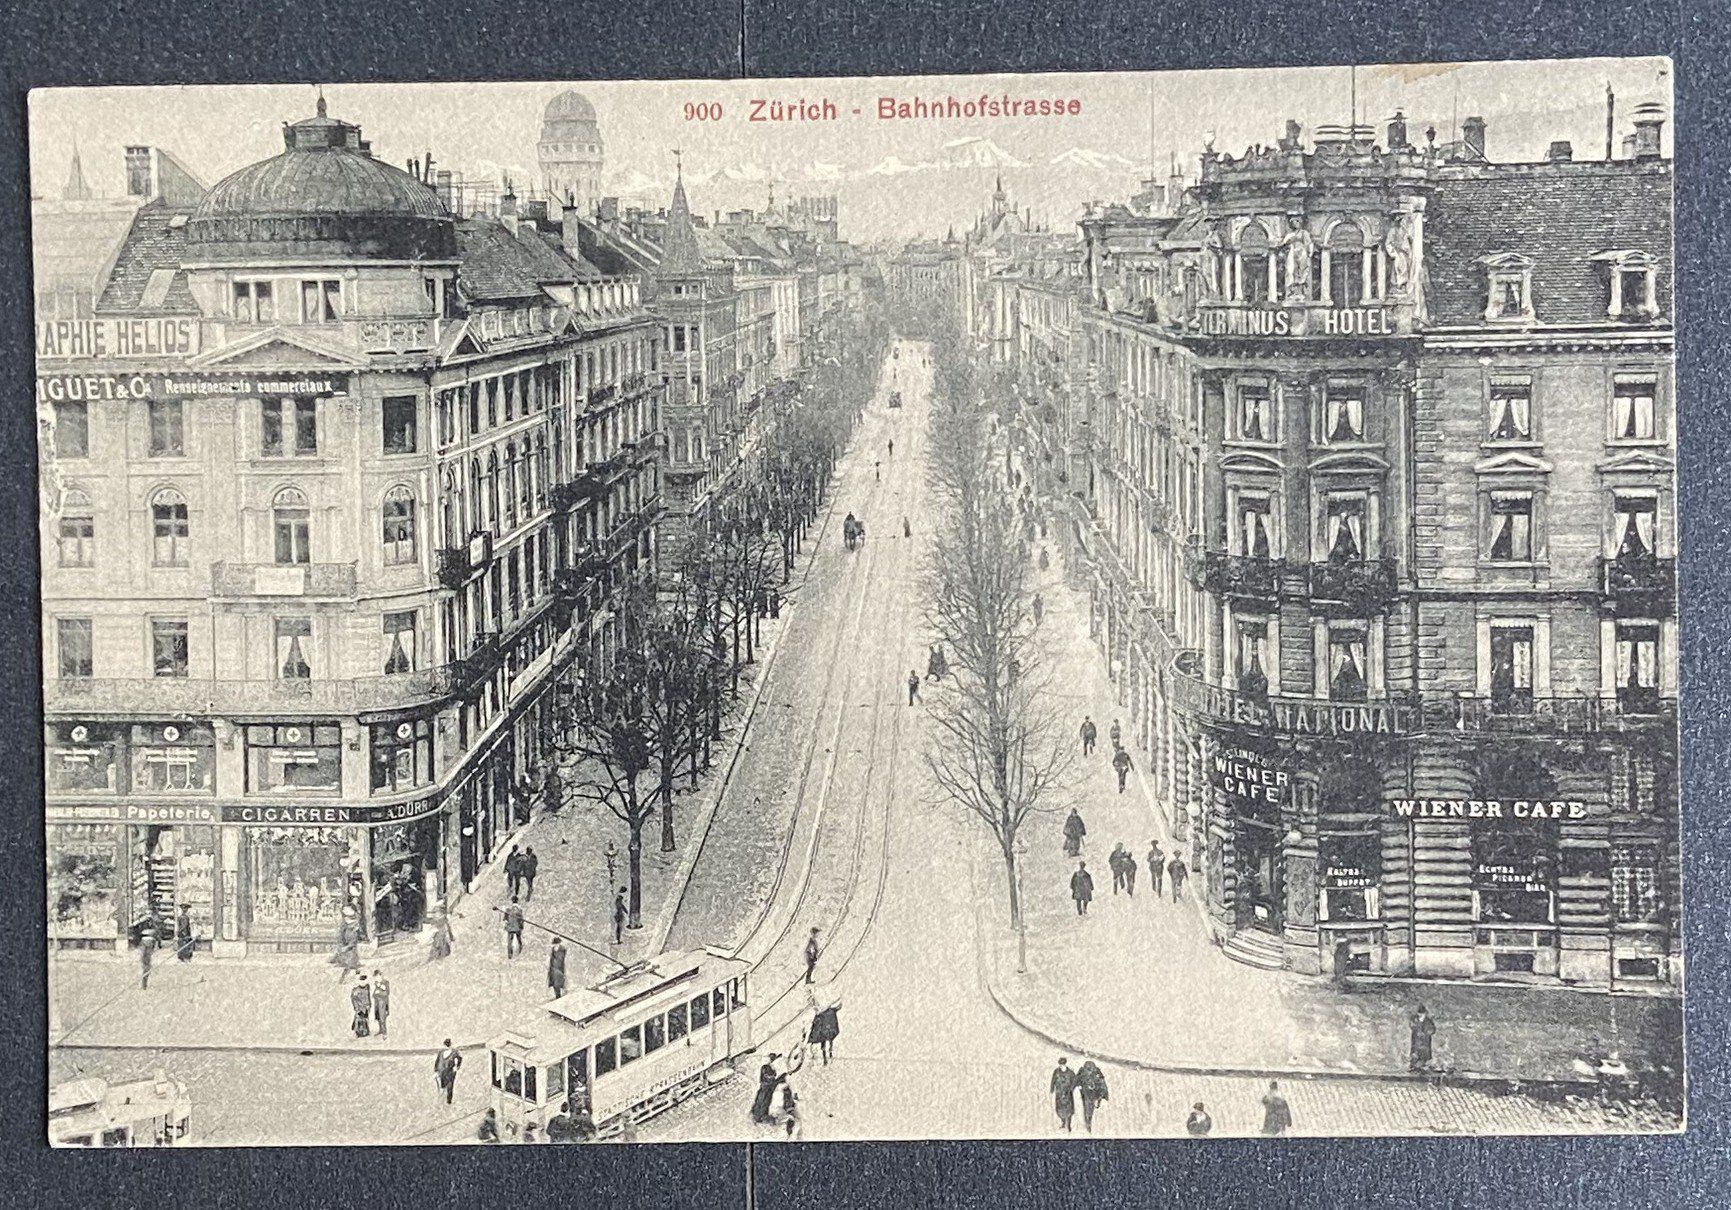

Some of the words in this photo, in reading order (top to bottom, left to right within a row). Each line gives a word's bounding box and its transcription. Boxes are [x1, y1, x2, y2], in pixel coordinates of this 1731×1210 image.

[1324, 308, 1392, 334] HOTEL
[36, 320, 106, 356] APHIE
[116, 319, 190, 355] HELIOS
[1215, 756, 1288, 787] WIENER
[1224, 776, 1279, 803] CAFE
[241, 808, 351, 822] CIGARREN
[1392, 801, 1503, 818] WIENER
[1513, 801, 1588, 818] CAFE
